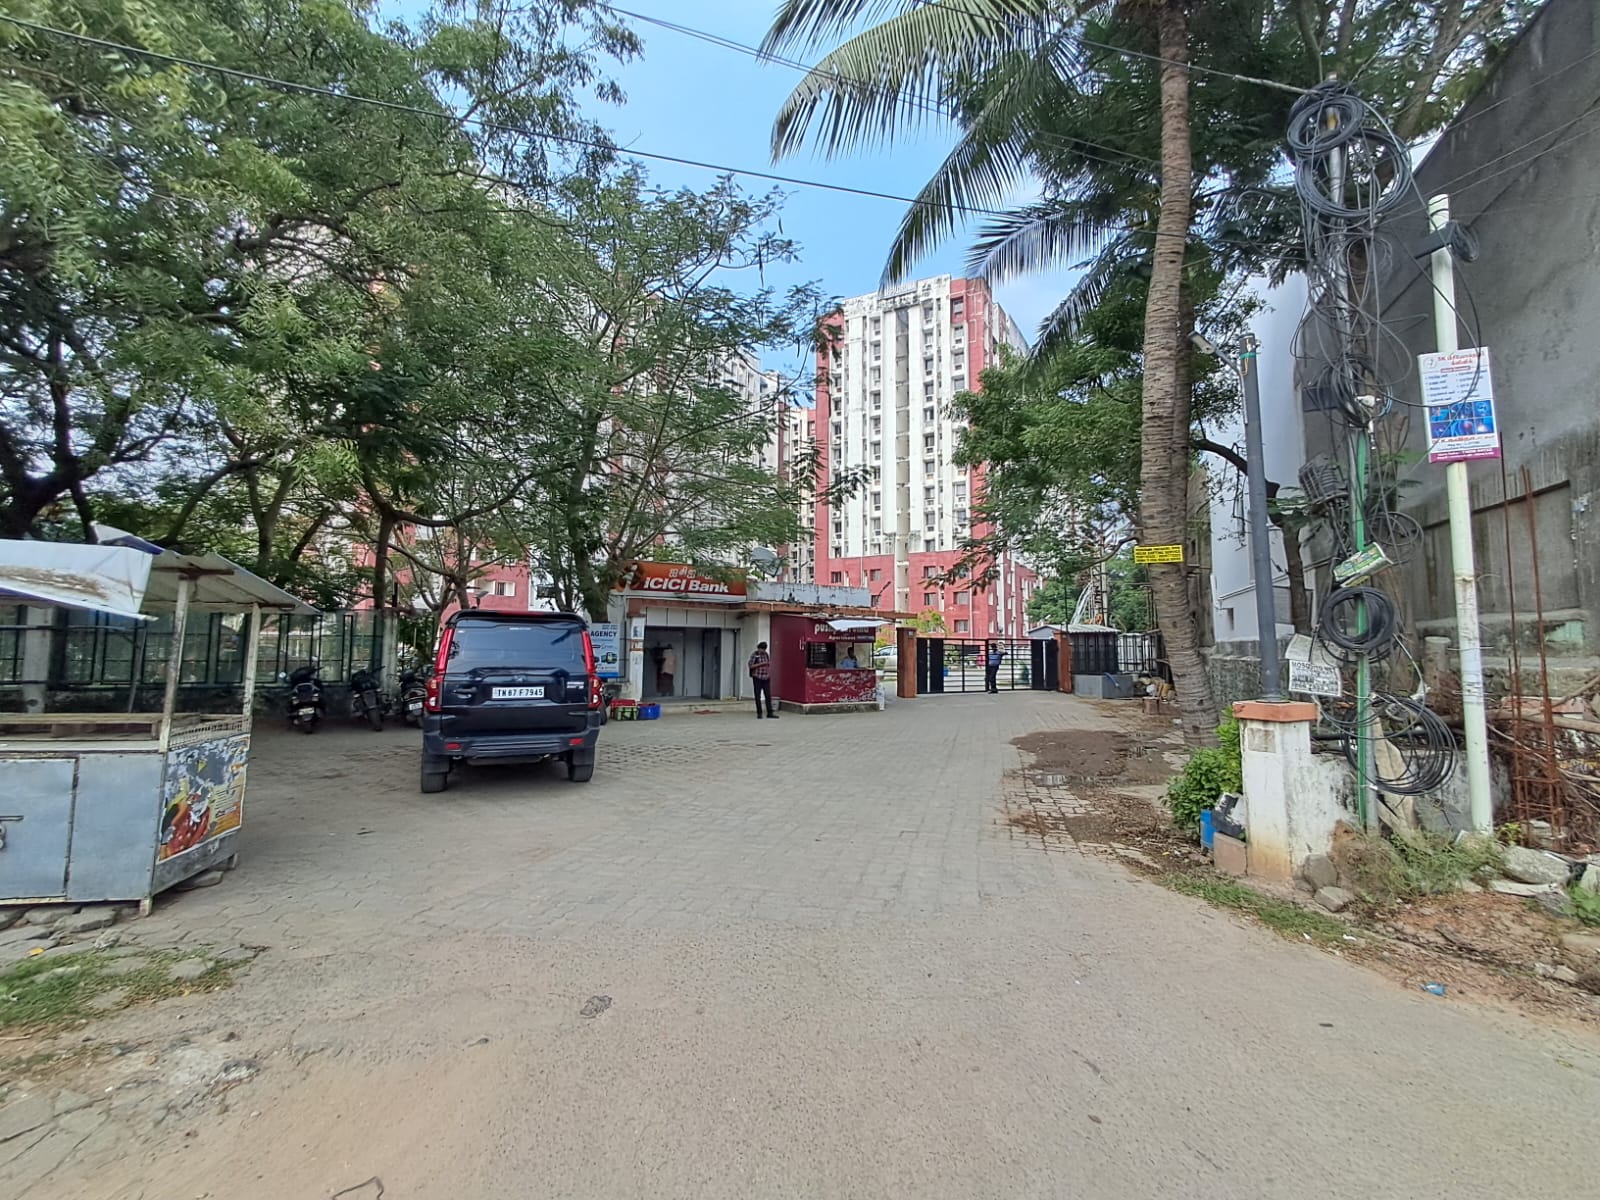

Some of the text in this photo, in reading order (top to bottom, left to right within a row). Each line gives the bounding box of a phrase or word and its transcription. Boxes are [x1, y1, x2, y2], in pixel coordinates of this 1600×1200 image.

[643, 576, 729, 593] ICICI Bank
[525, 688, 543, 696] 7945
